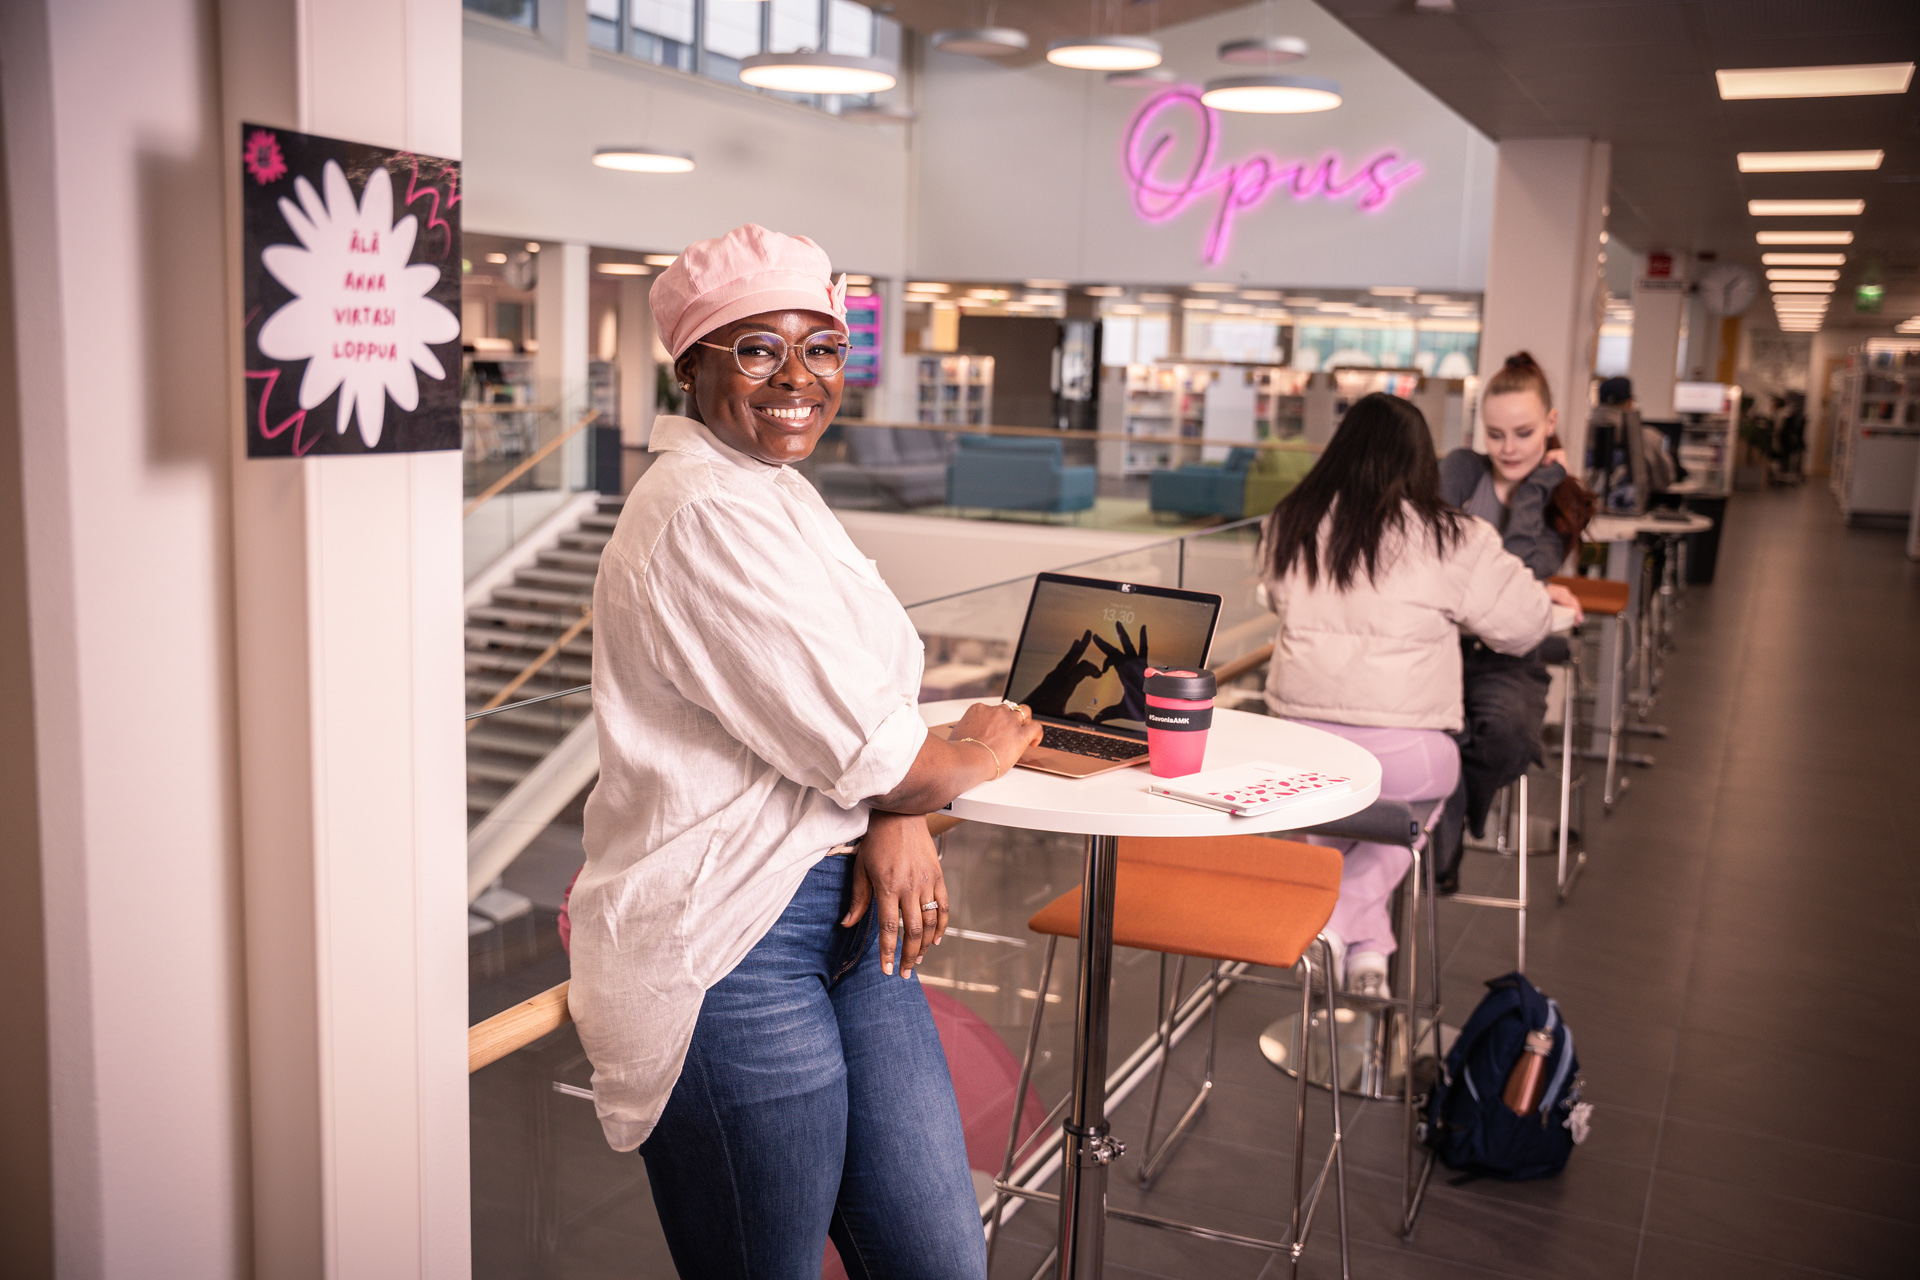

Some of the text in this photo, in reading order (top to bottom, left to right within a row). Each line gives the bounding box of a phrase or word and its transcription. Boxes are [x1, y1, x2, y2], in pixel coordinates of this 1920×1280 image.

[1123, 87, 1421, 266] Opus
[349, 229, 380, 254] ÄLÄ
[344, 271, 386, 291] ANNA
[333, 307, 396, 326] VIRTASI
[332, 340, 398, 361] LOPPUA
[1148, 714, 1190, 725] #SavoniaAMK
